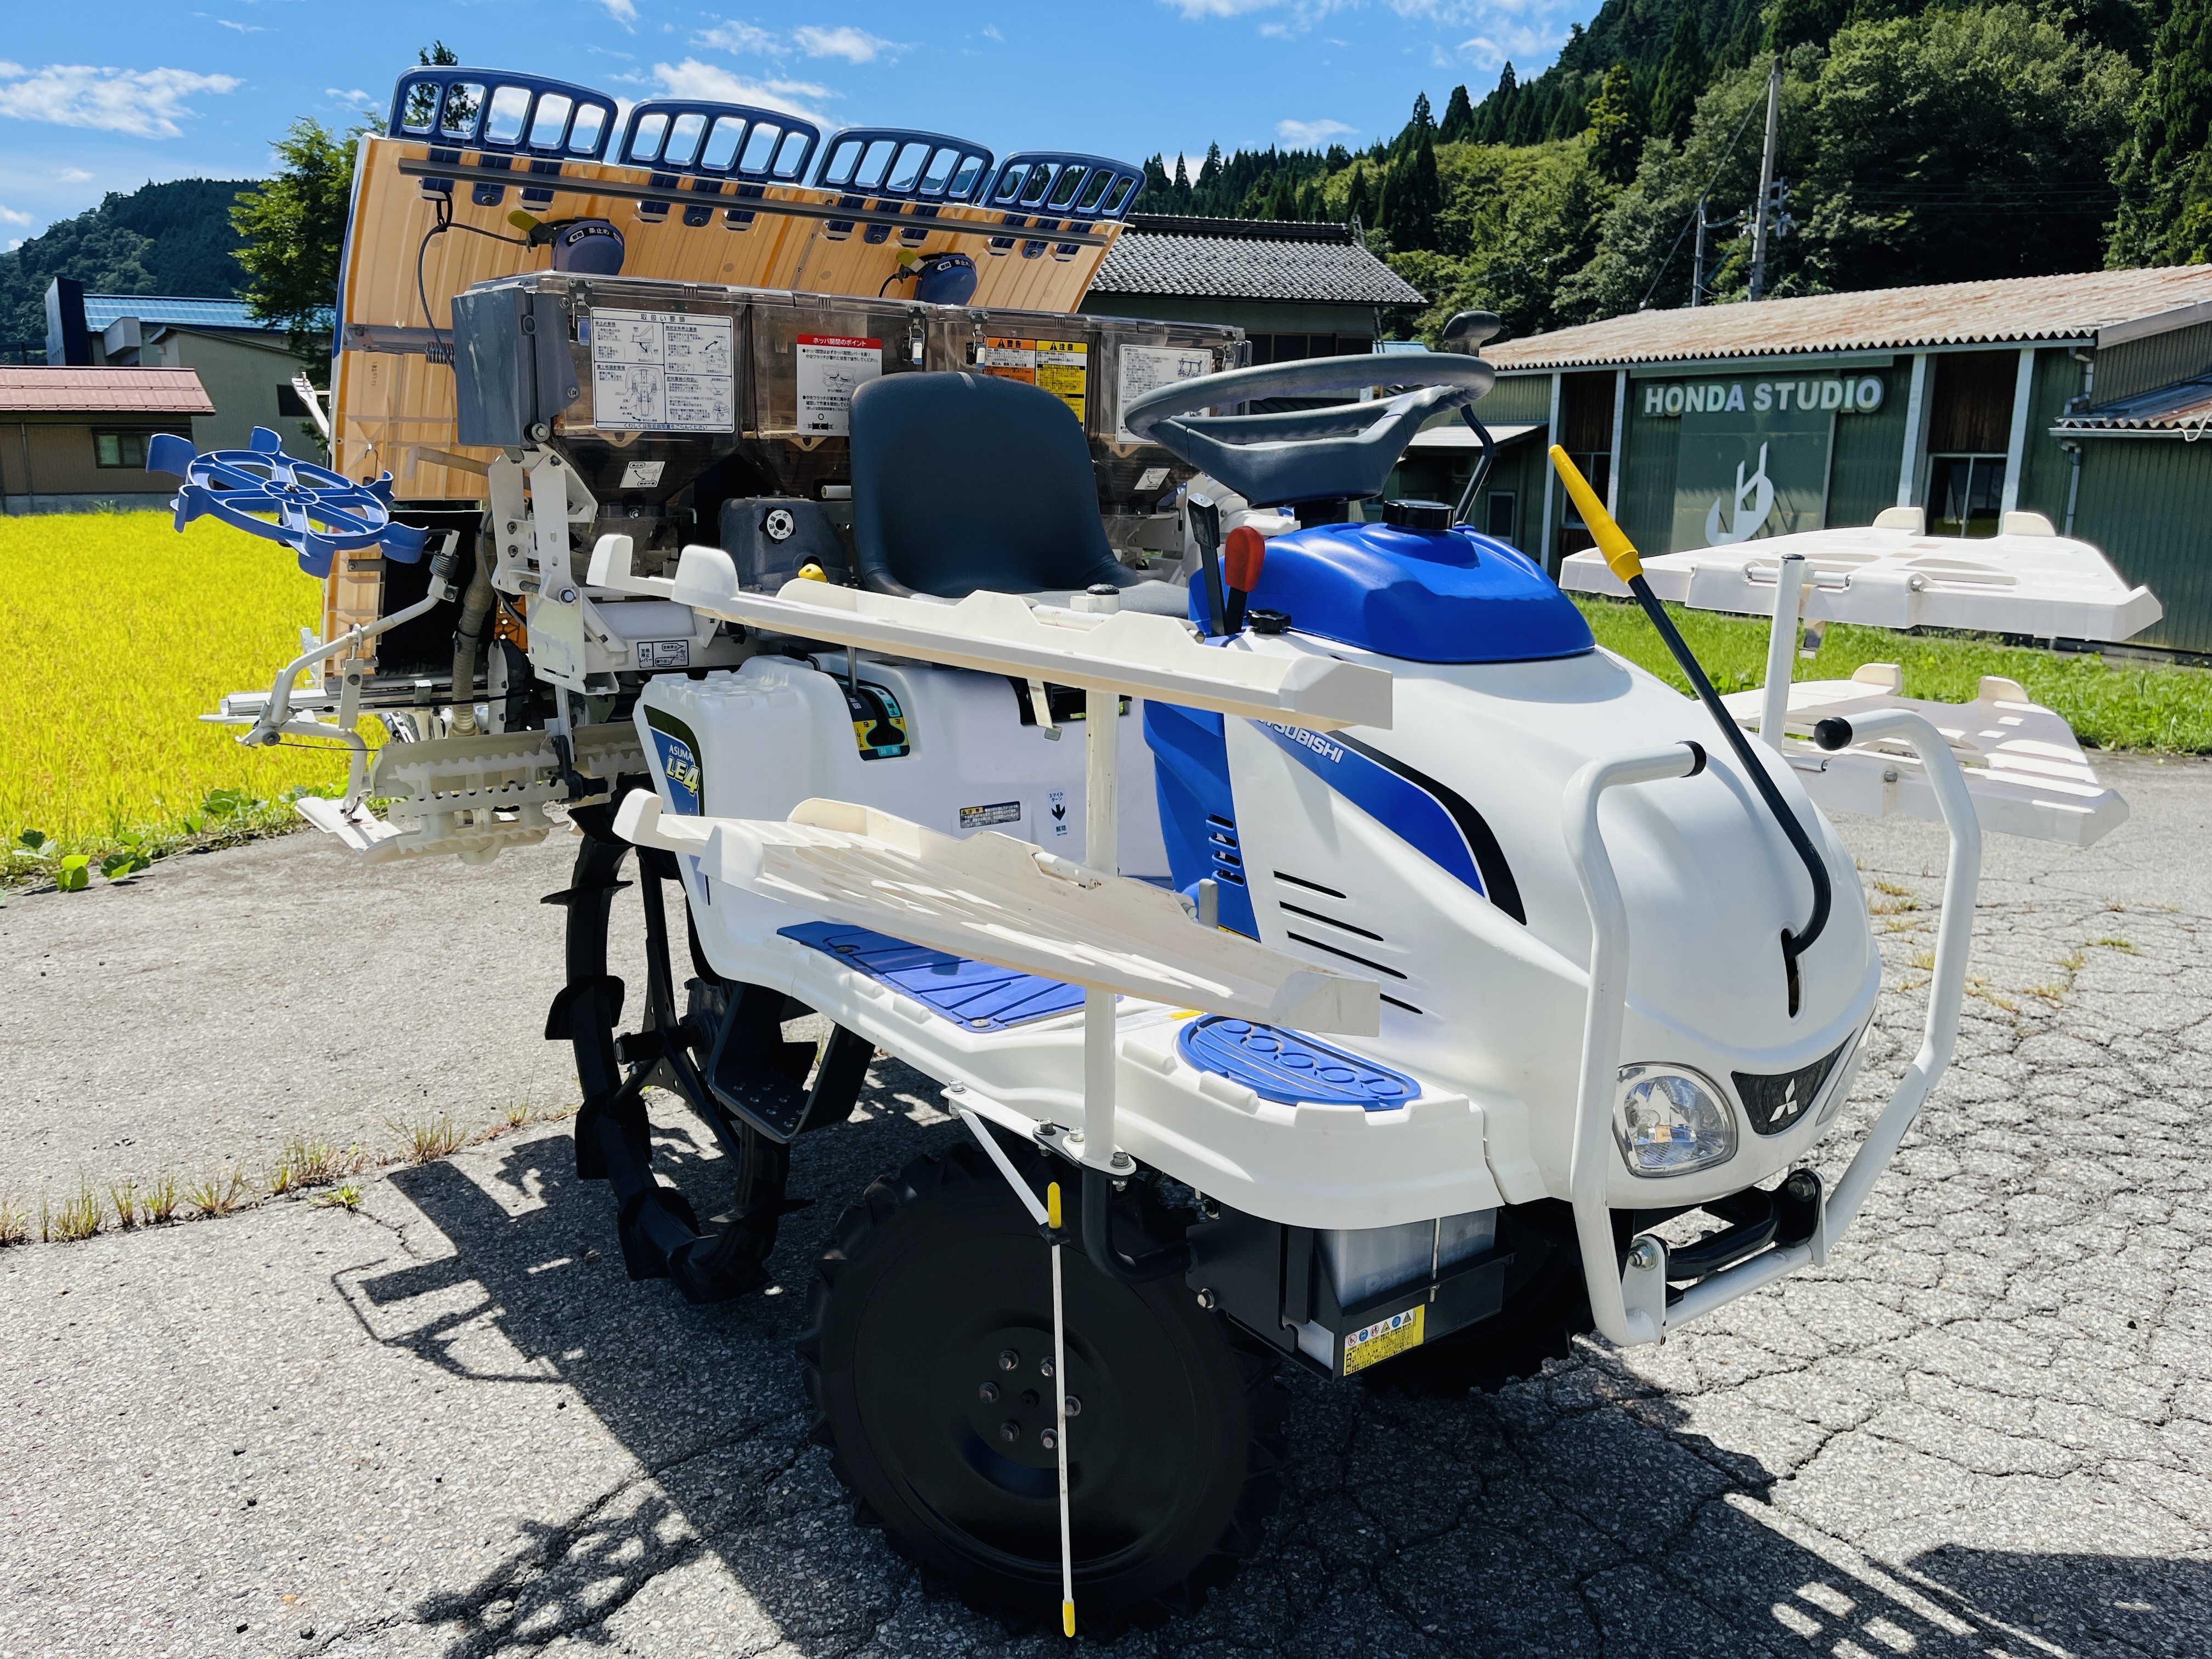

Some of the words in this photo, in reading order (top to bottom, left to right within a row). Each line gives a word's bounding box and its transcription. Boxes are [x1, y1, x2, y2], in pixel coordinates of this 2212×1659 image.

[813, 337, 867, 347] ホッパ開閉のポイント
[1645, 384, 1746, 414] HONDA
[1753, 379, 1882, 412] STUDIO
[669, 744, 693, 762] ASUMA
[667, 756, 699, 796] LE4
